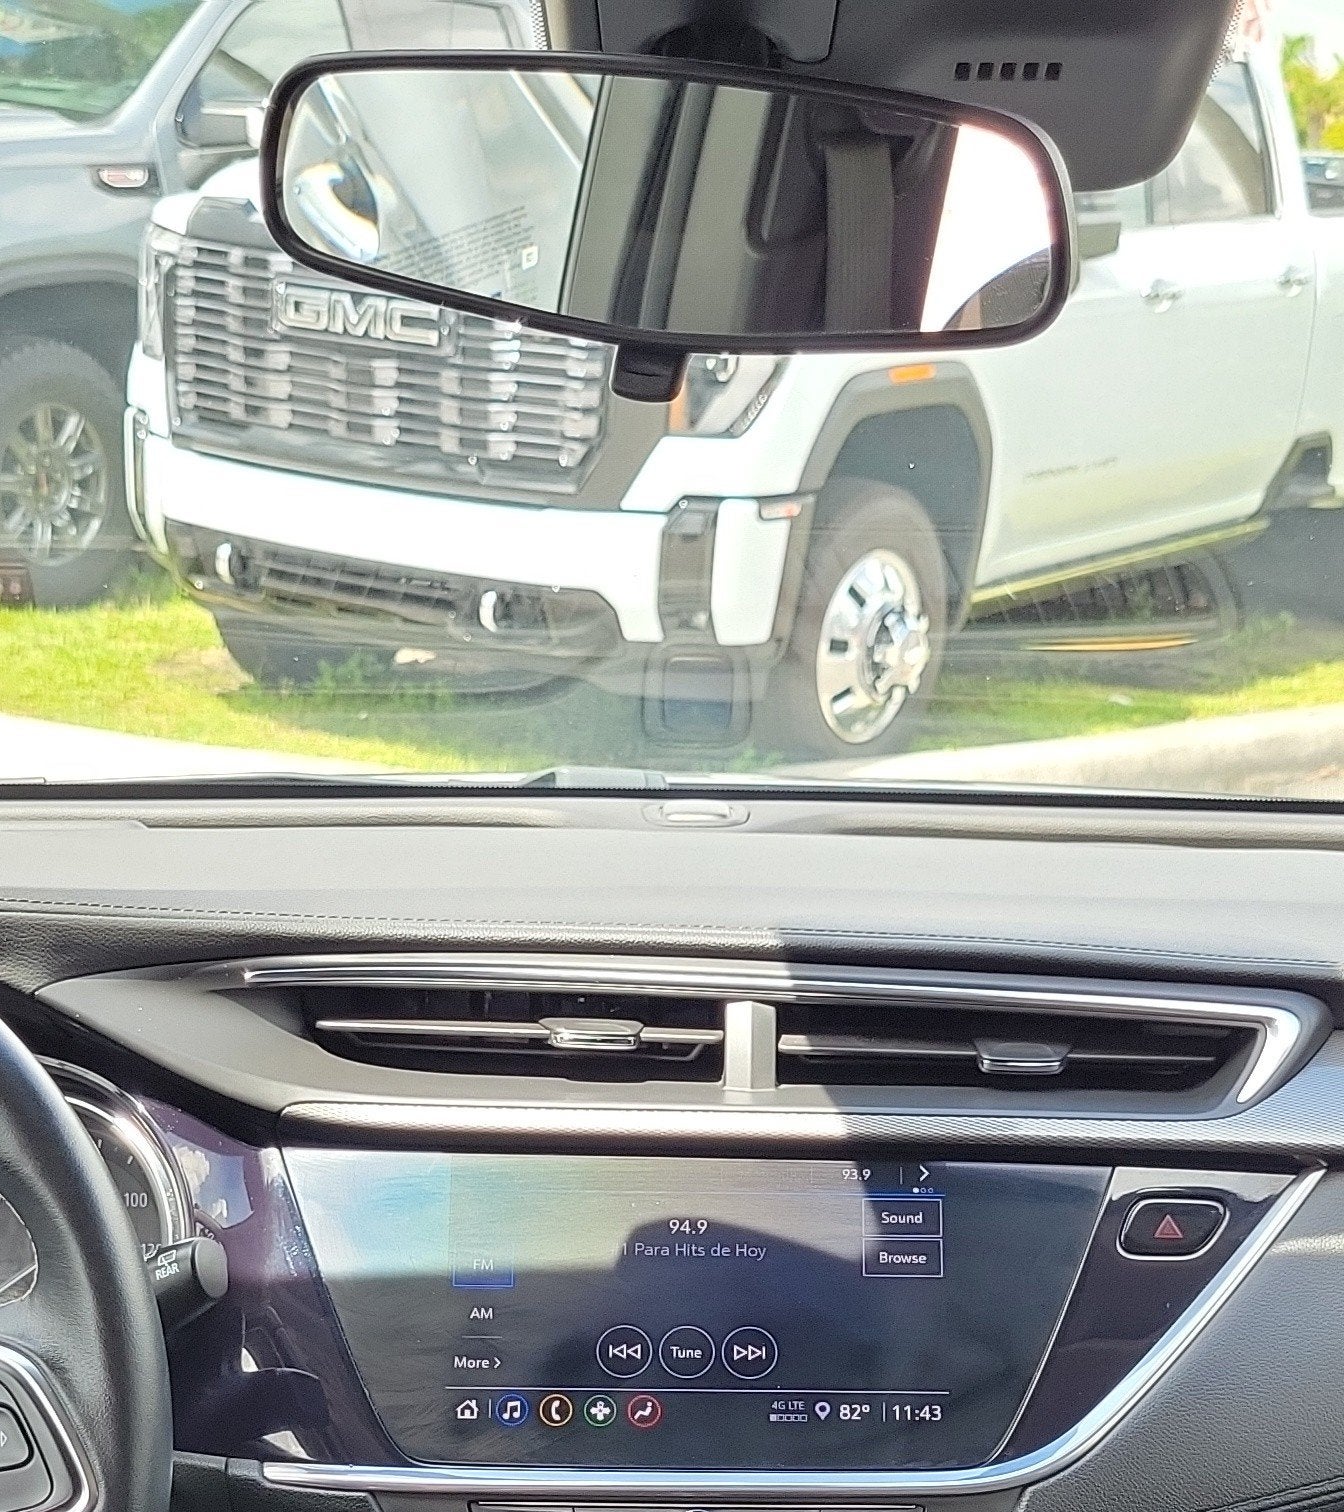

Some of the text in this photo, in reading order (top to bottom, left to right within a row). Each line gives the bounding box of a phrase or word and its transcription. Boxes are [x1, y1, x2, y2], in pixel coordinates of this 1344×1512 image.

[278, 284, 441, 347] GMC
[842, 1168, 872, 1181] 93.9
[123, 1191, 149, 1208] 100
[881, 1211, 923, 1224] Sound
[668, 1219, 708, 1235] 94.9
[634, 1243, 670, 1256] Para
[675, 1243, 706, 1257] Hits
[710, 1243, 732, 1257] de
[735, 1244, 766, 1261] Hoy
[879, 1251, 927, 1264] Browse
[155, 1262, 180, 1281] REAR
[473, 1259, 494, 1271] FM
[469, 1307, 494, 1320] AM
[669, 1345, 703, 1359] Tune
[453, 1356, 490, 1369] More
[771, 1400, 806, 1411] 4G LTE
[892, 1404, 943, 1421] 11:43
